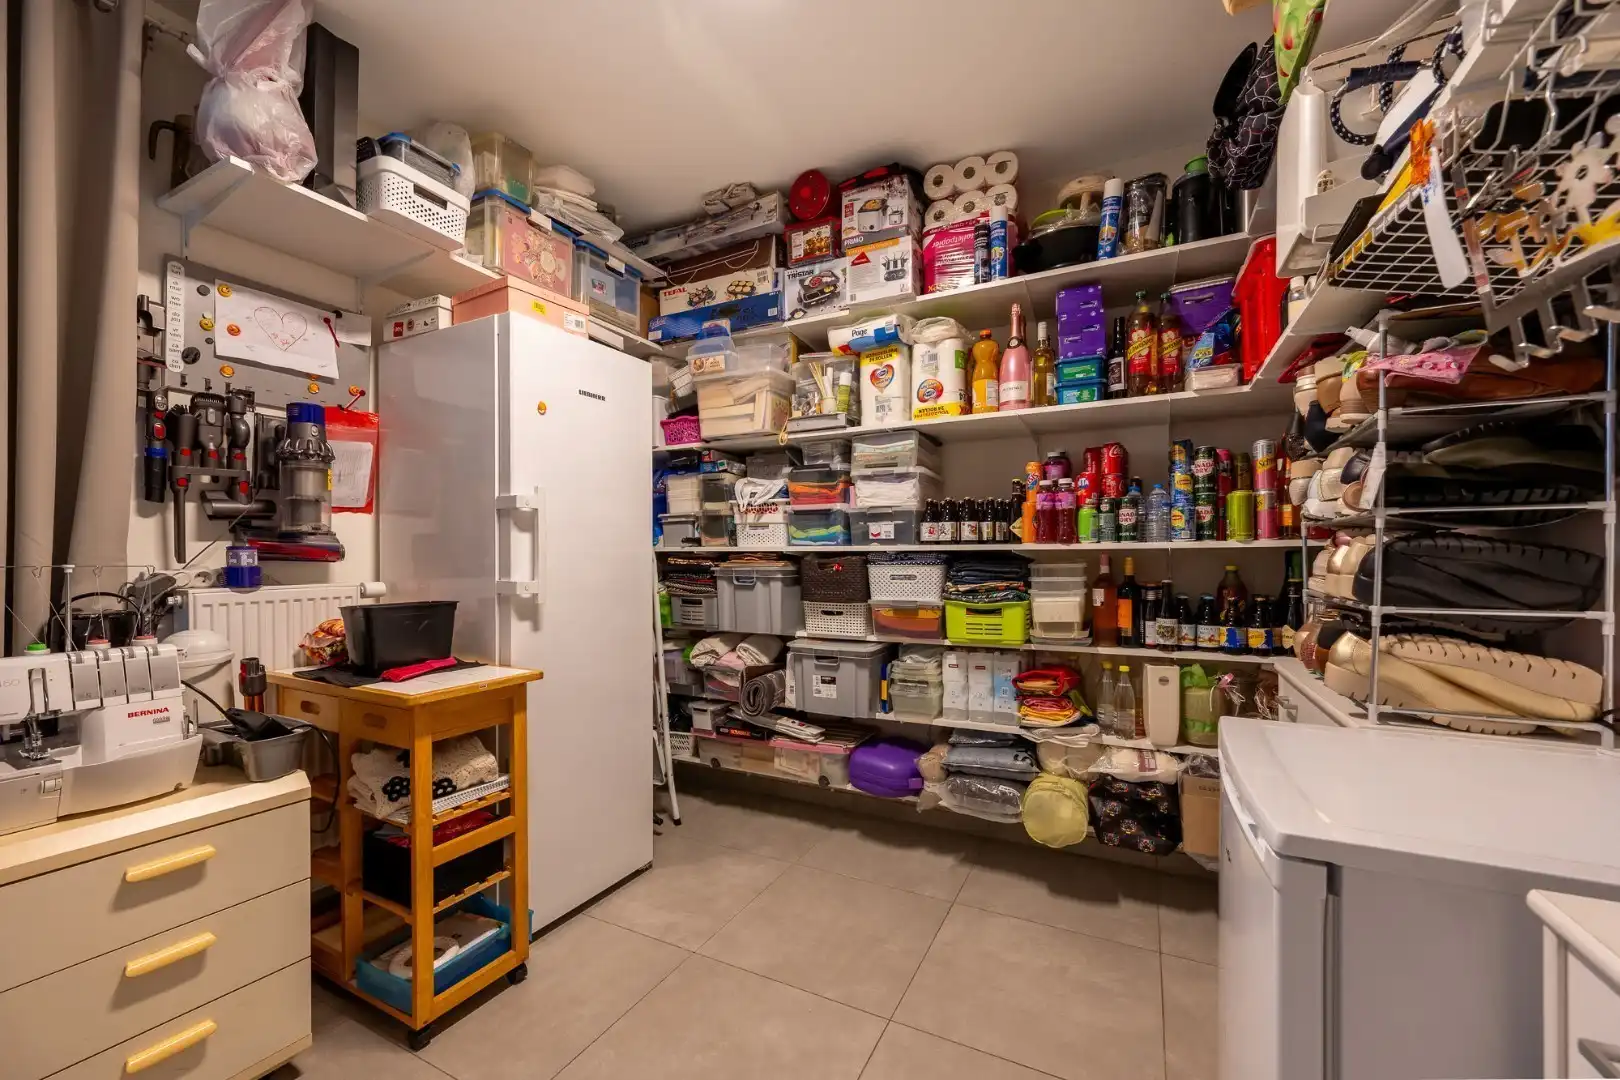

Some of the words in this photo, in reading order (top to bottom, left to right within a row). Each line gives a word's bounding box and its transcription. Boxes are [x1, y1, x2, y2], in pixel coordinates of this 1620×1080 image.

[844, 236, 864, 247] PRIMO
[787, 269, 815, 280] TRISTAR
[663, 287, 688, 297] TEFAL
[851, 328, 868, 337] Page
[578, 389, 606, 401] LIEBHERR
[127, 707, 170, 718] BERNINA
